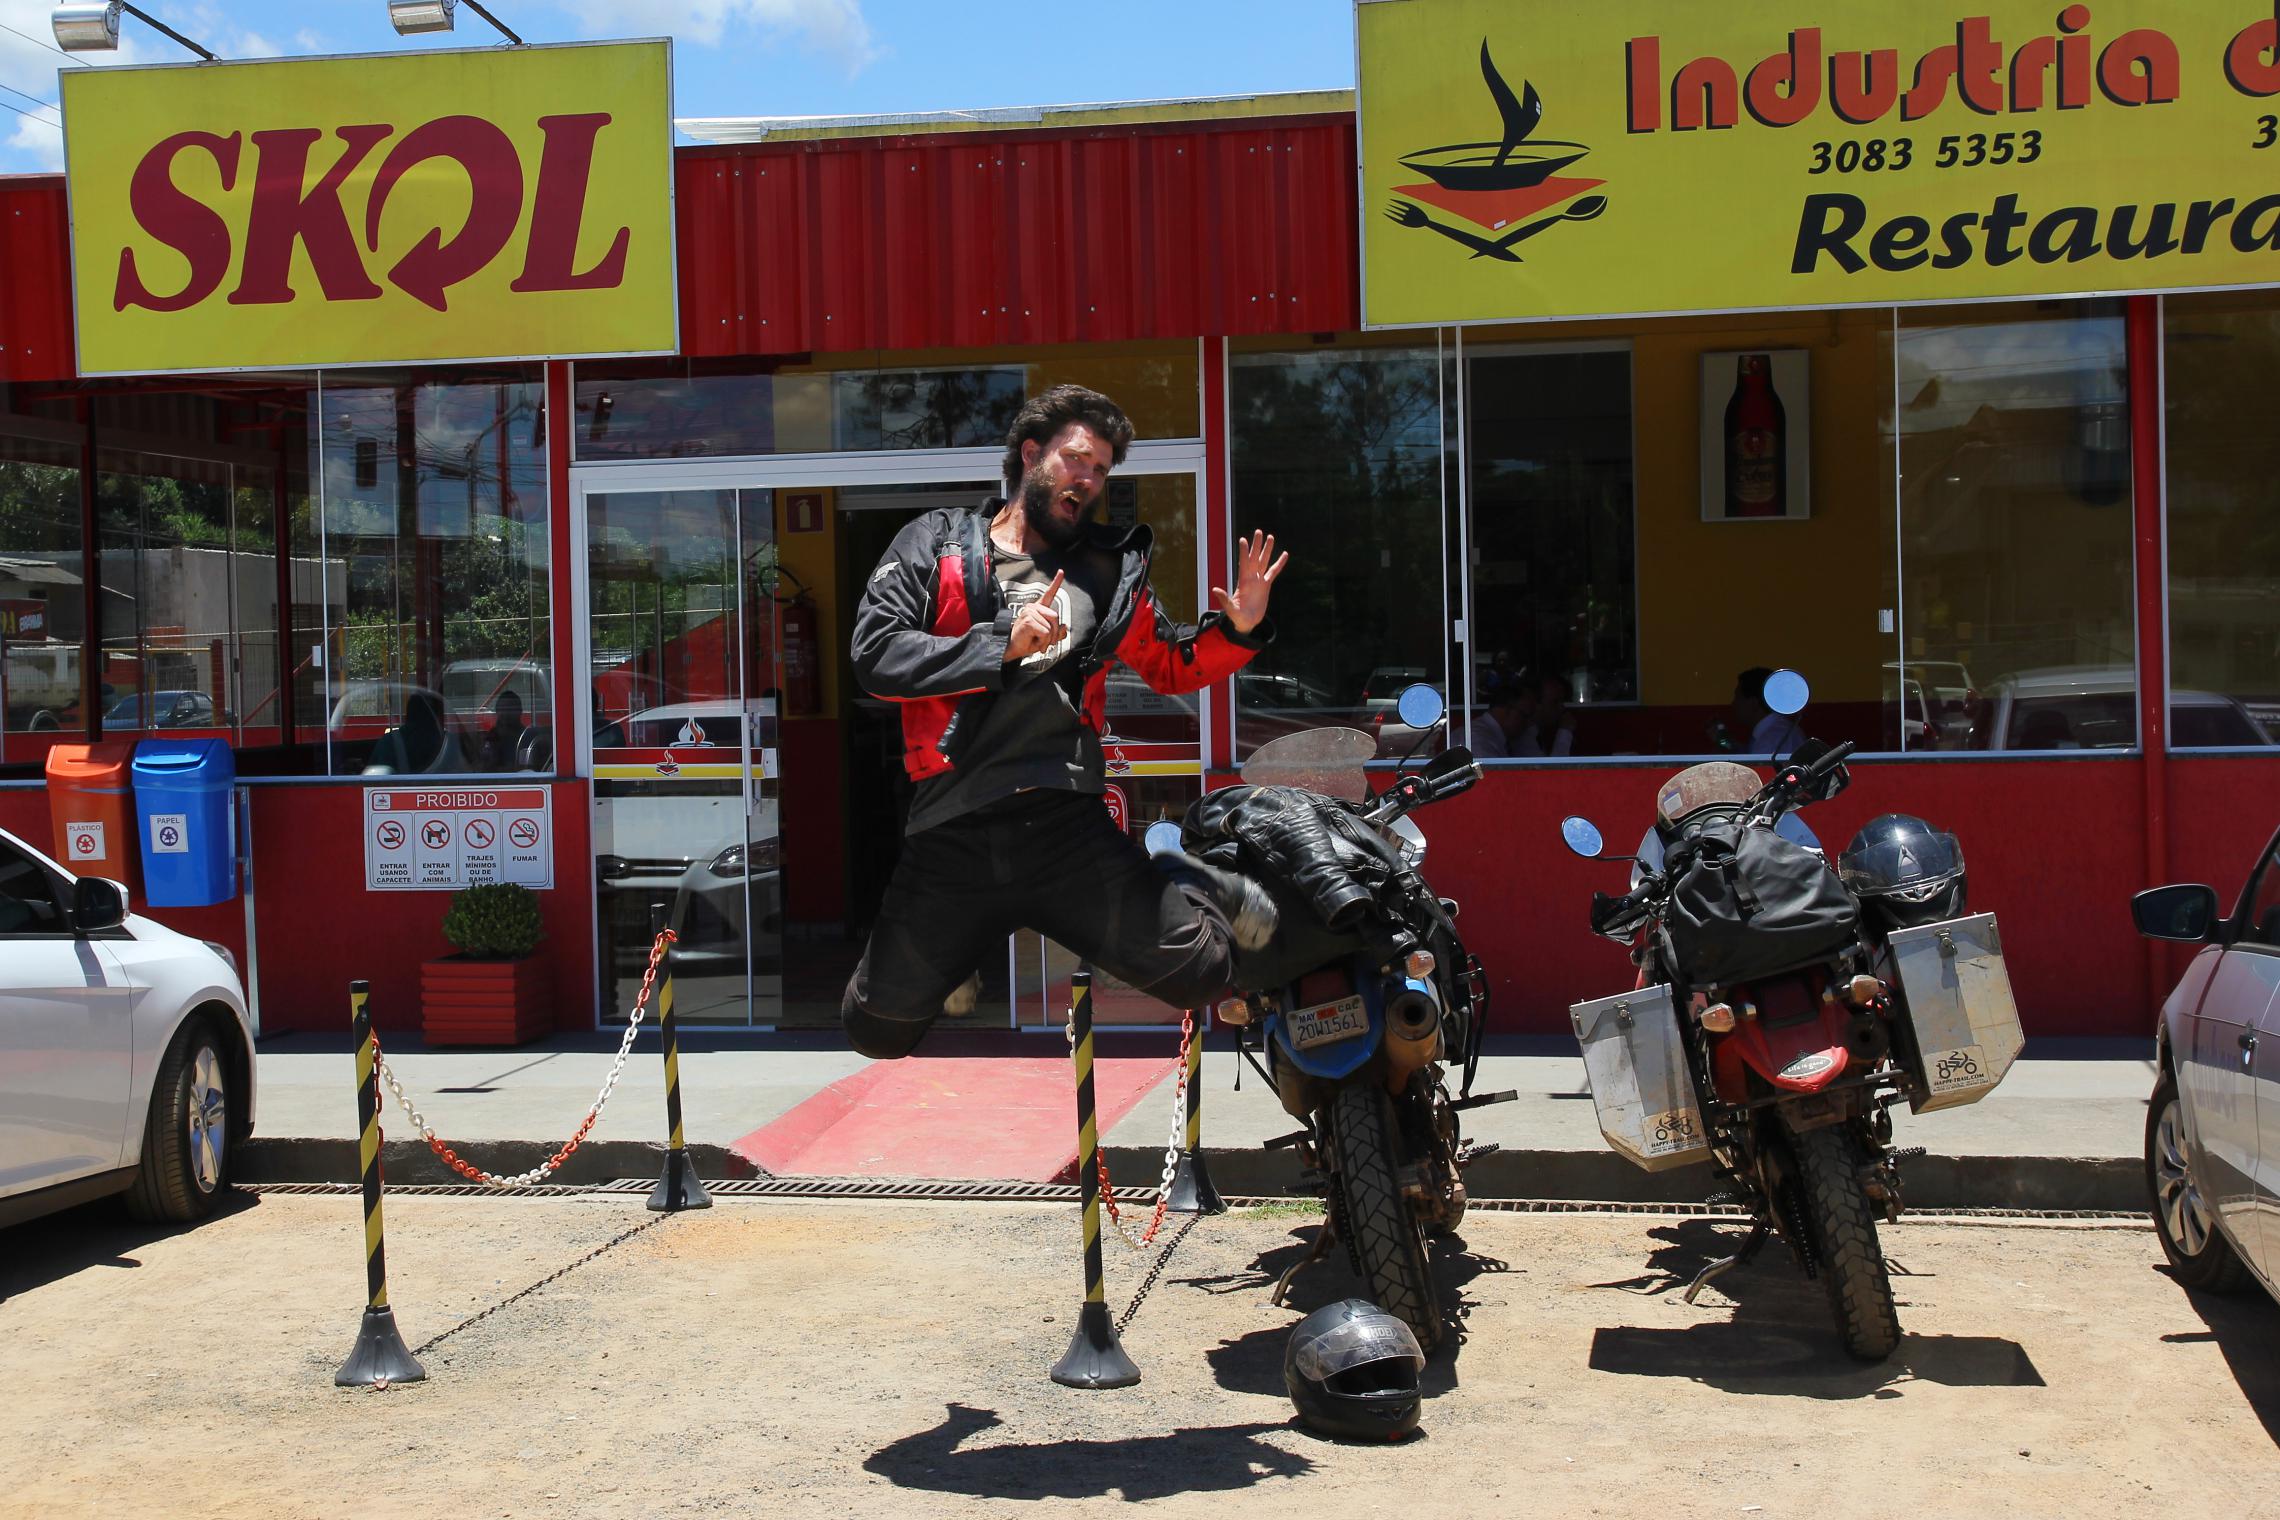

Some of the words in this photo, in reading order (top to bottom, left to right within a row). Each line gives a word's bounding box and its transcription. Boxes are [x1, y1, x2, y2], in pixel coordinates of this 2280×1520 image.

[1625, 4, 2180, 134] Industria
[2252, 114, 2279, 149] 3
[1808, 138, 1913, 174] 3083
[1935, 131, 2043, 167] 5353
[113, 112, 630, 312] SKOL
[1790, 192, 2280, 275] Restaura
[416, 793, 497, 808] PROIBIDO
[69, 824, 102, 832] PLÁSTICO
[1297, 1012, 1359, 1042] 20W1561
[1299, 1012, 1316, 1024] MAY
[1934, 1073, 1985, 1086] HAPPY-TRAIL.COM
[1363, 1326, 1394, 1338] HOEI
